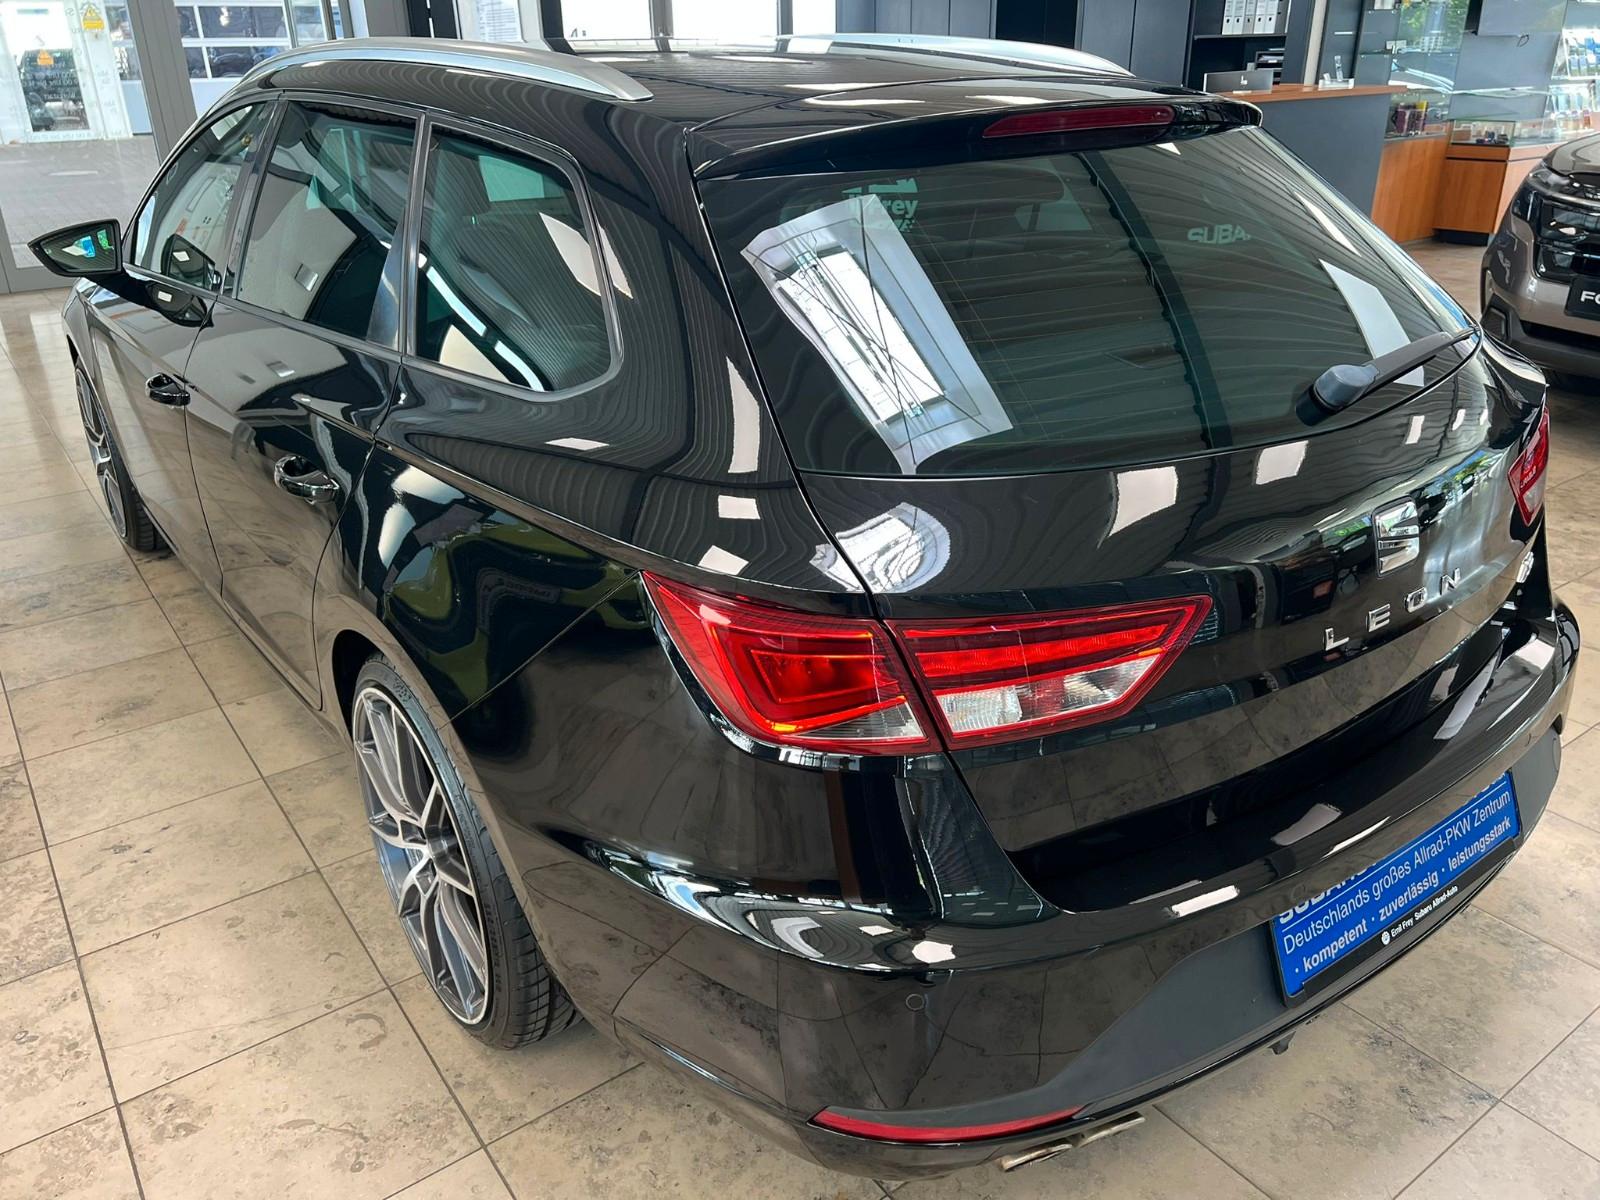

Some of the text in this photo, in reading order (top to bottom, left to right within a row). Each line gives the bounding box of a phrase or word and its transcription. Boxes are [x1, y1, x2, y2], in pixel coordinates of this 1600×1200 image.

[1323, 567, 1461, 651] LEON
[1283, 887, 1370, 955] Deutschlands
[1372, 859, 1412, 902] großes
[1413, 815, 1471, 868] Allrad-PKW
[1472, 790, 1511, 826] Zentrum
[1303, 920, 1368, 973] kompetent
[1378, 871, 1440, 922] zuverlässig
[1448, 815, 1512, 872] leistungsstark
[1414, 903, 1433, 921] Subaru
